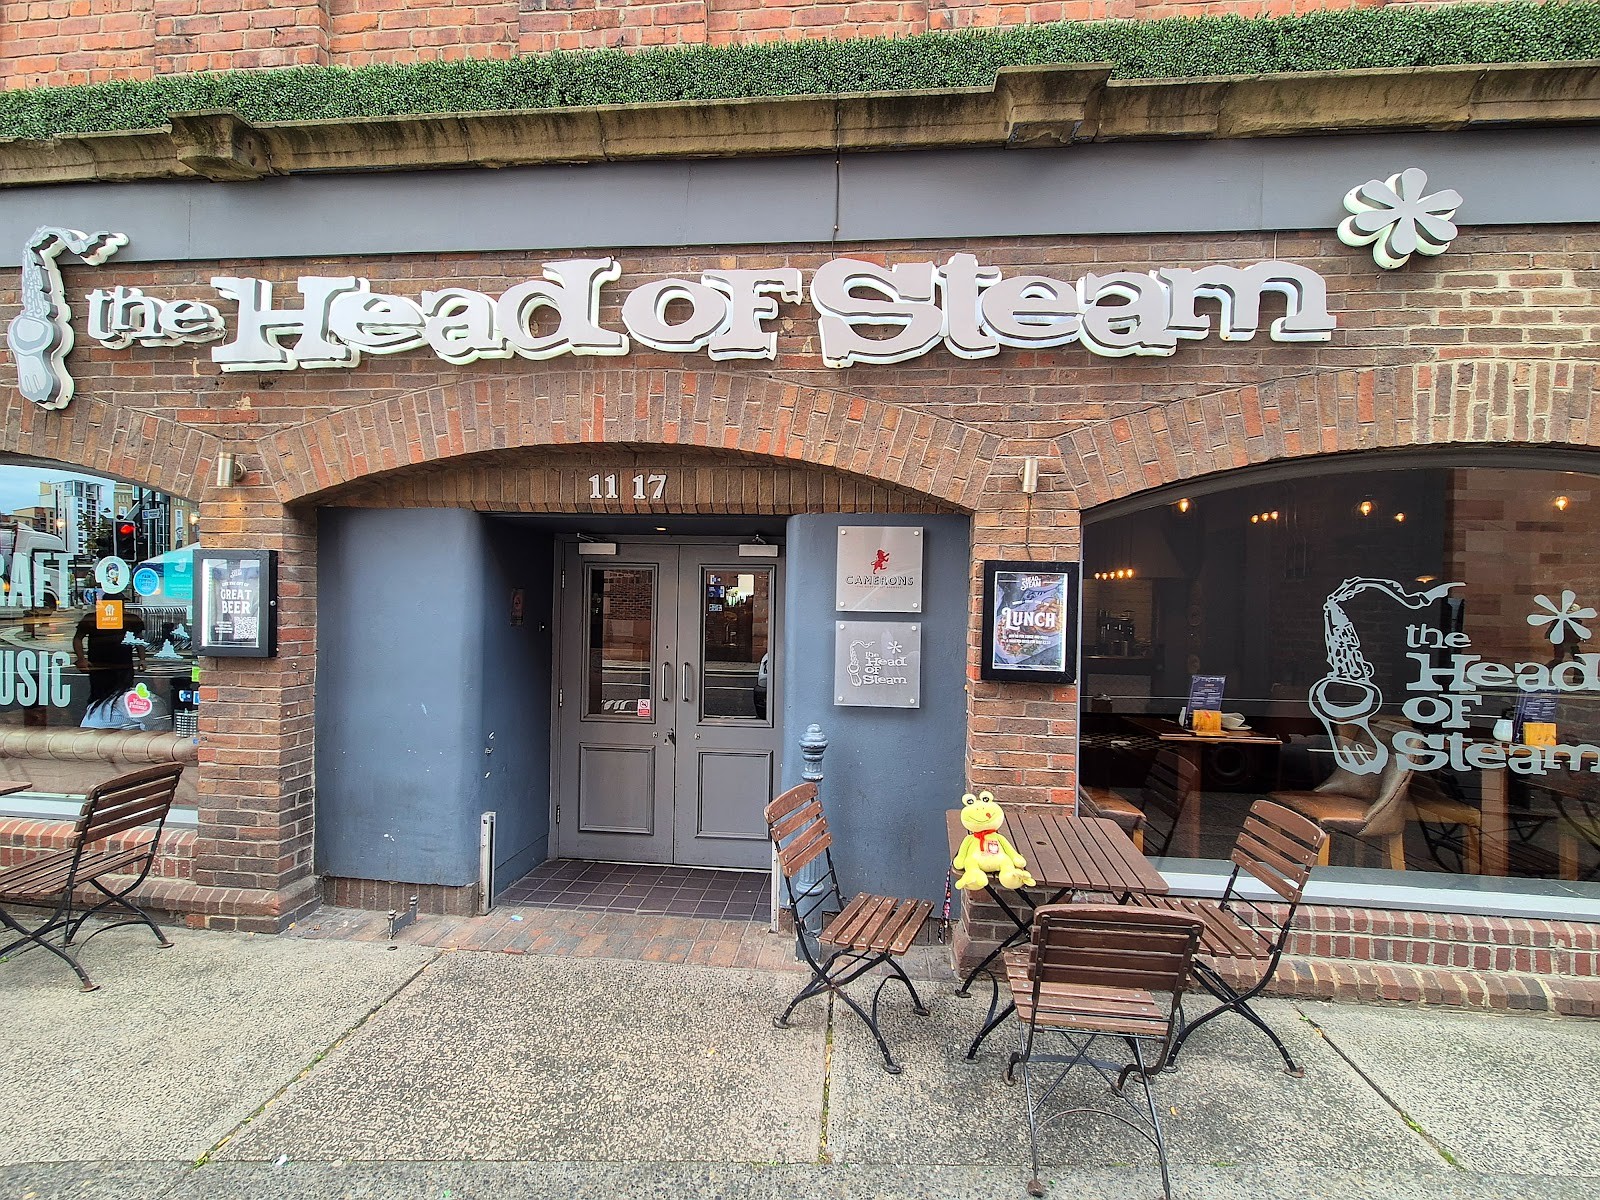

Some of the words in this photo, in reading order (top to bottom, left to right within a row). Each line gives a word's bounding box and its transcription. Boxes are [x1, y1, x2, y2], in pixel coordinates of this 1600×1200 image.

[87, 285, 226, 350] the
[210, 256, 629, 372] Head
[810, 252, 1336, 369] Steam
[588, 473, 619, 499] 11
[632, 474, 668, 499] 17
[0, 552, 74, 609] AFT
[846, 575, 915, 586] CAMERONS
[220, 588, 253, 600] GREAT
[221, 600, 252, 614] BEER
[1405, 623, 1472, 649] the
[865, 656, 908, 666] Head
[1405, 652, 1600, 692] Head
[862, 675, 908, 685] Steam
[1391, 731, 1600, 775] Steam
